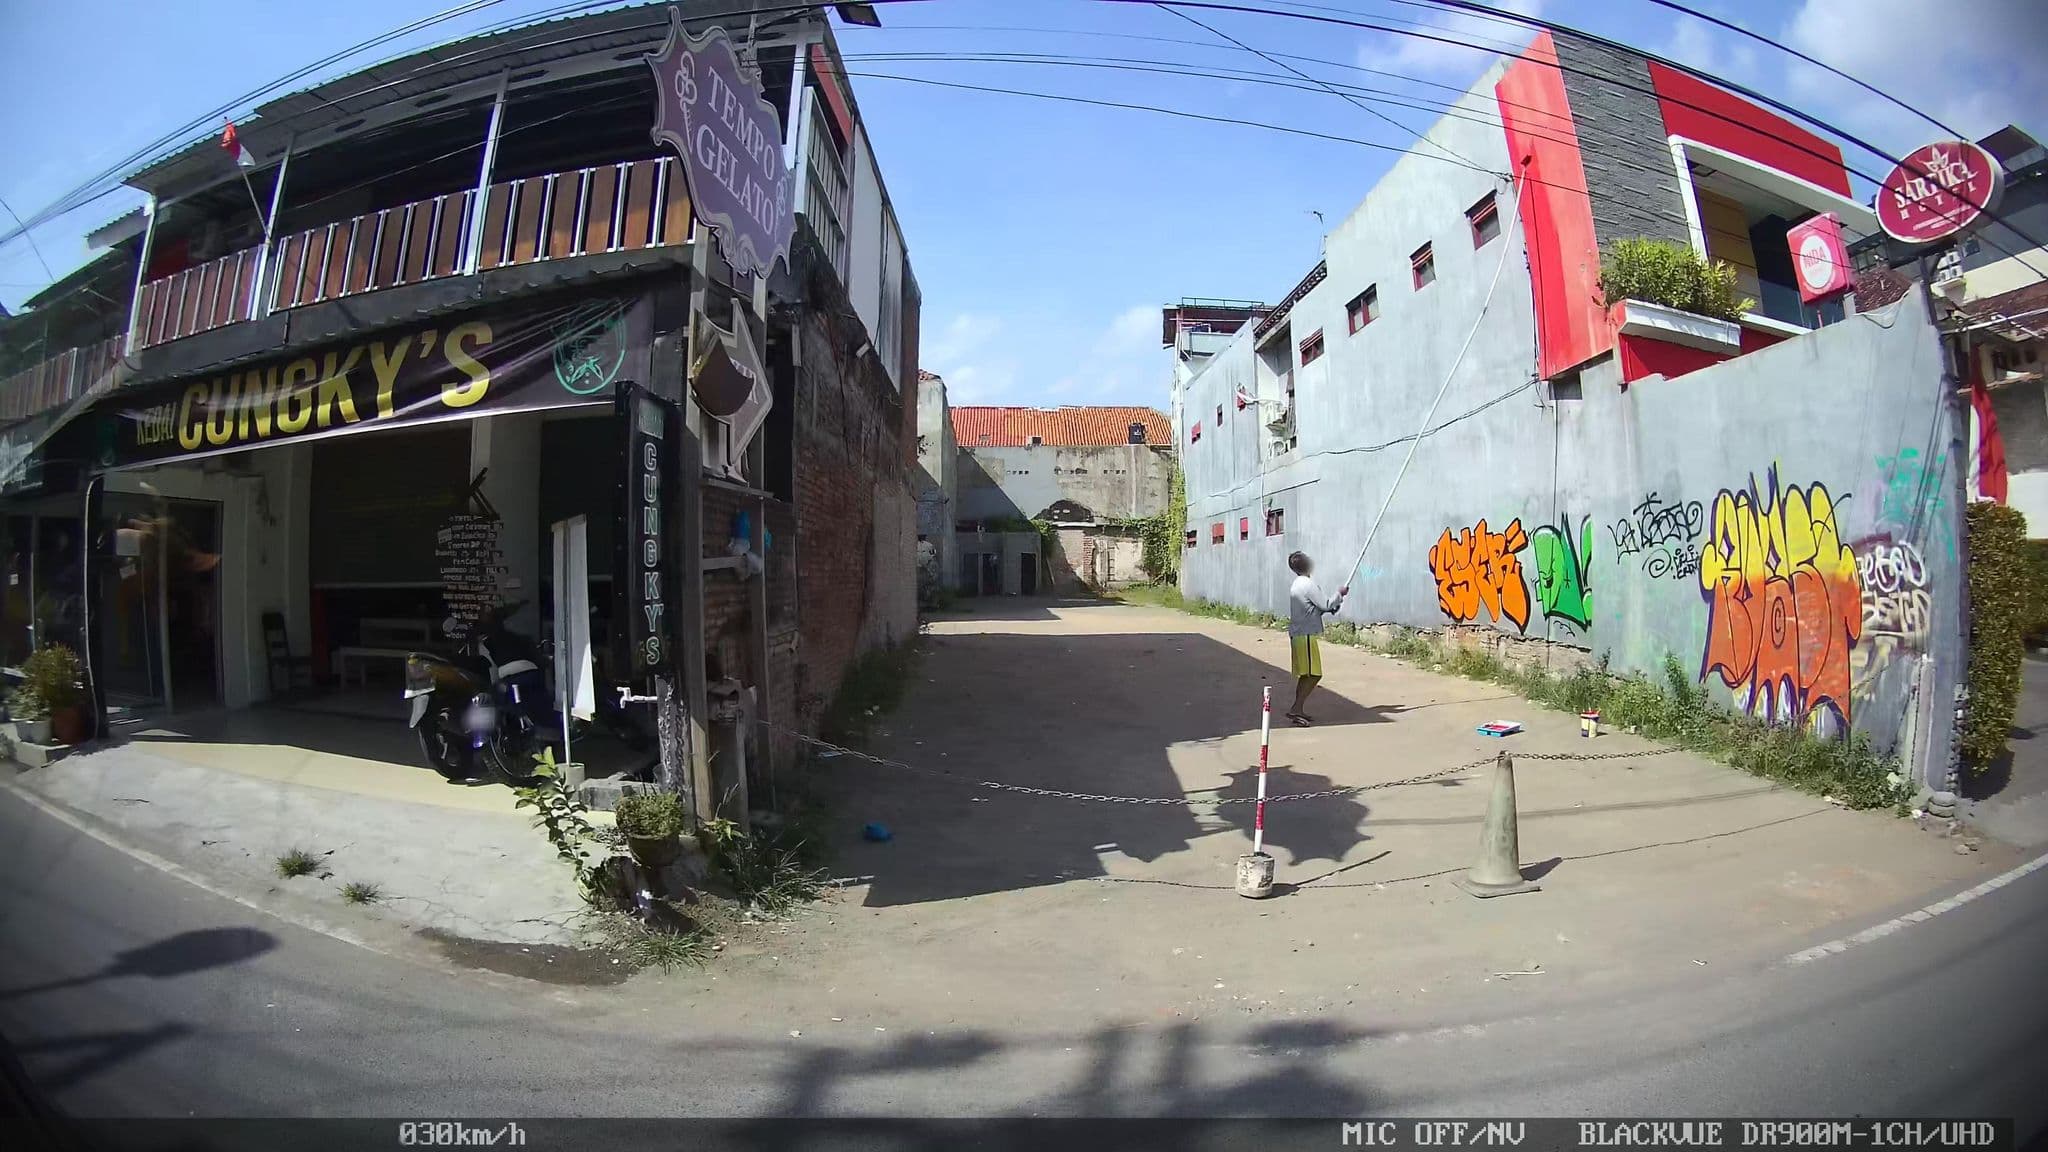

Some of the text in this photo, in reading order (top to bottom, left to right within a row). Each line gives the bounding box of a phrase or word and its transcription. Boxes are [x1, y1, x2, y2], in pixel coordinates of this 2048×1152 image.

[696, 123, 776, 236] GELATO
[706, 66, 776, 181] TEMPO
[136, 320, 493, 451] KEDAI CUNGKY'S
[643, 441, 665, 666] CUNGKY'S
